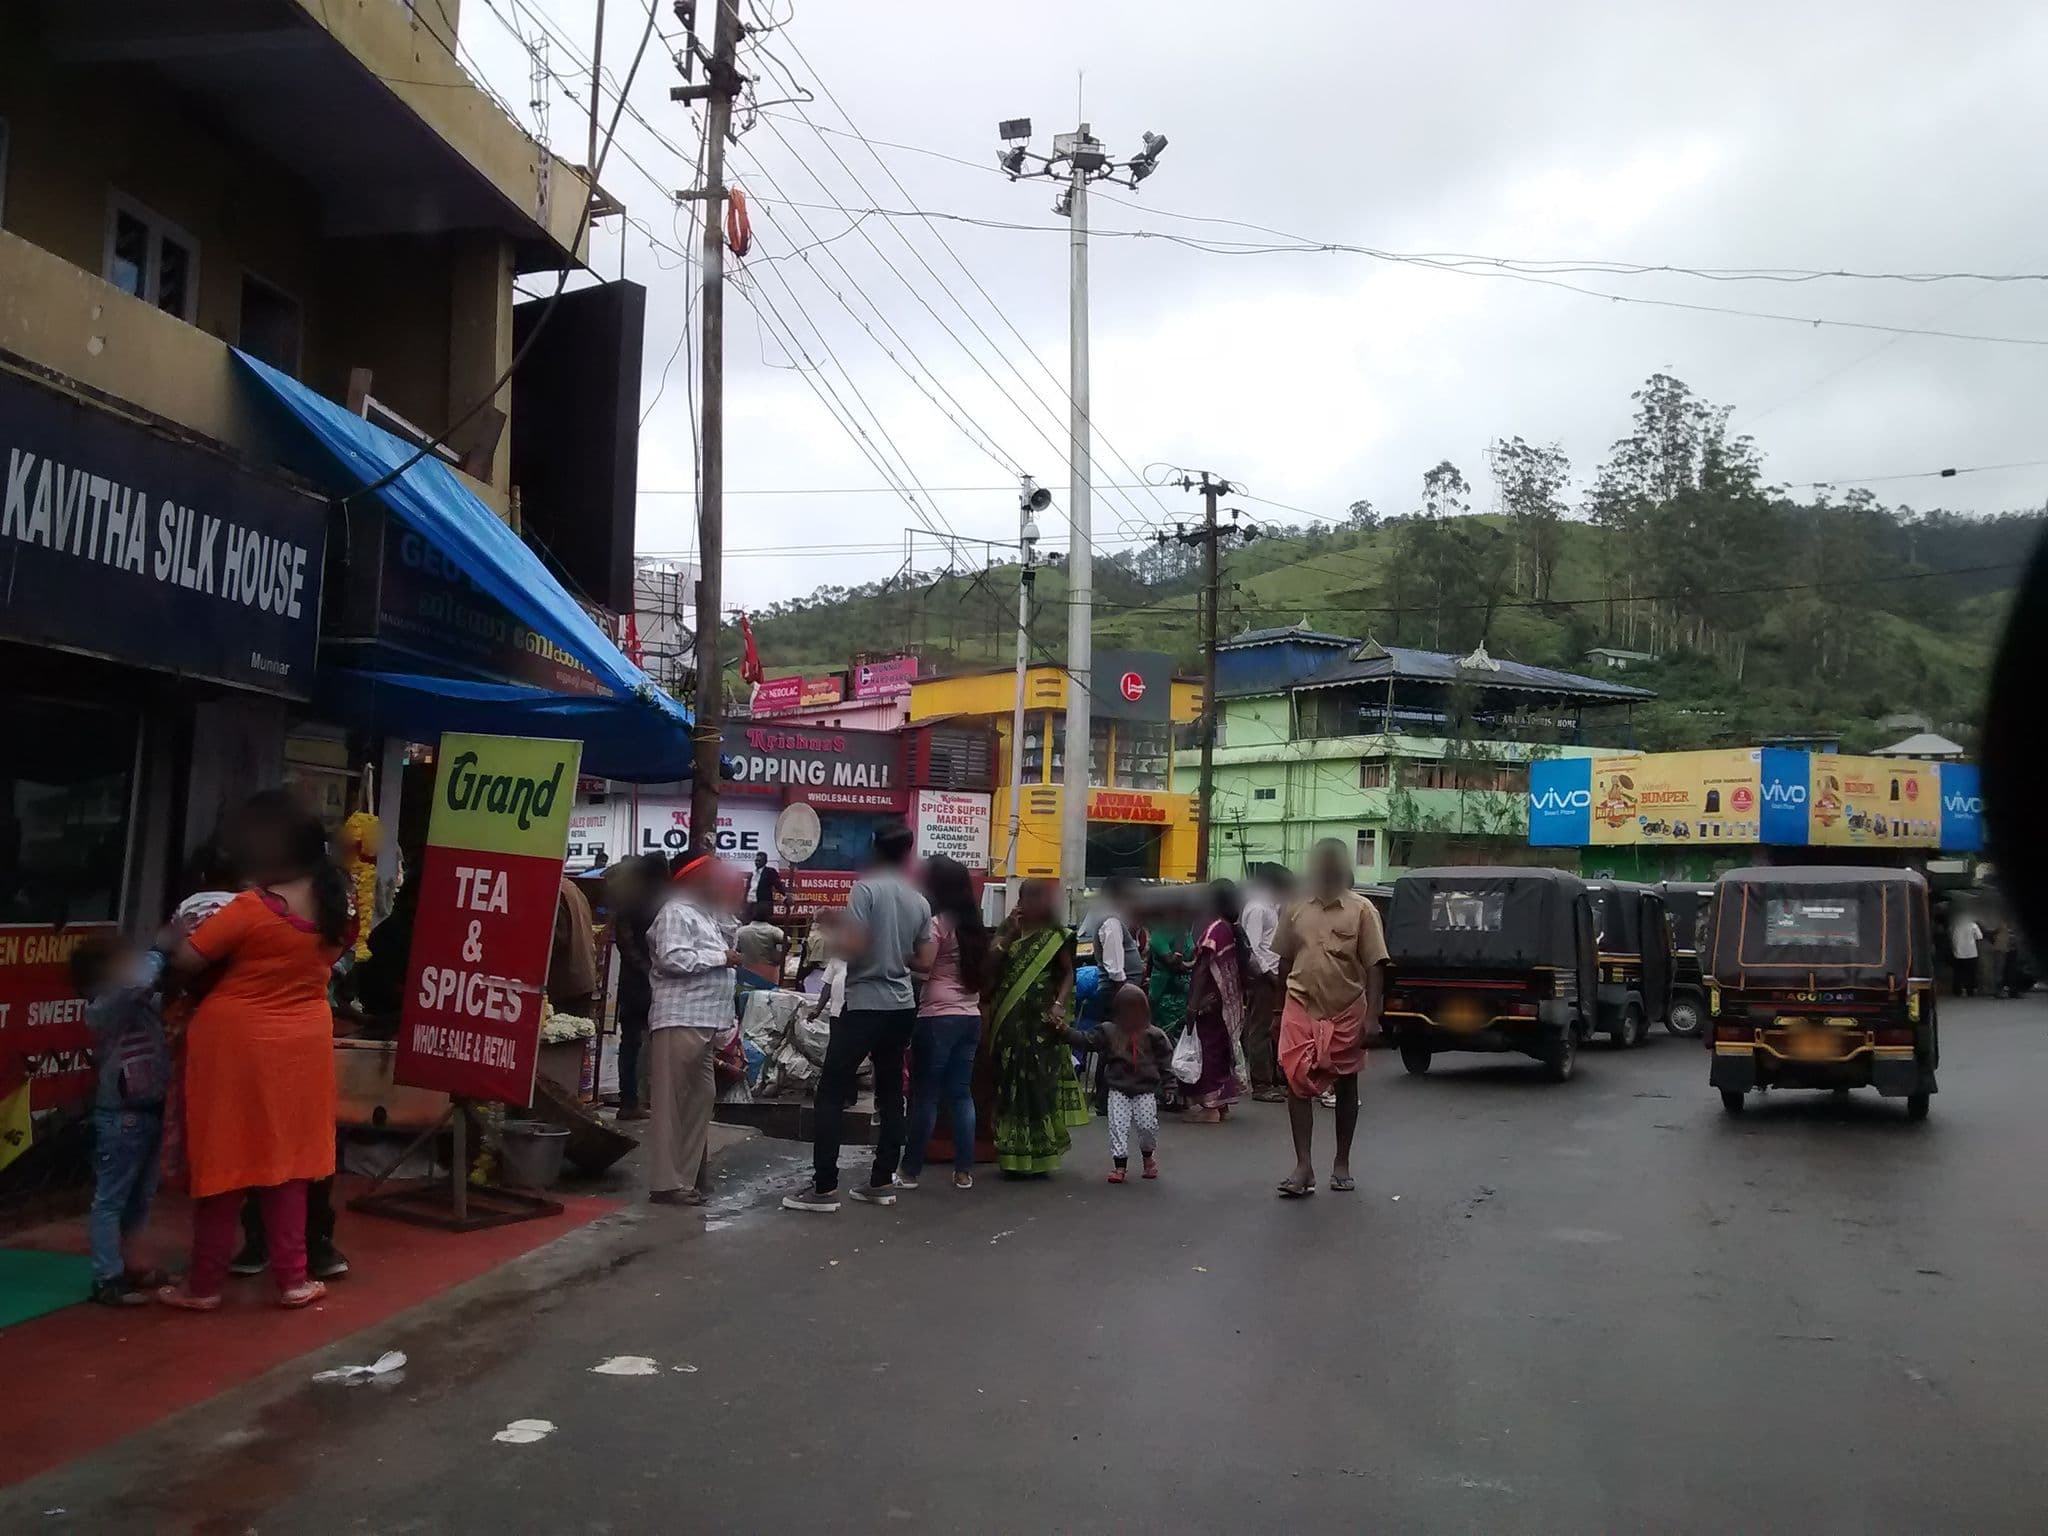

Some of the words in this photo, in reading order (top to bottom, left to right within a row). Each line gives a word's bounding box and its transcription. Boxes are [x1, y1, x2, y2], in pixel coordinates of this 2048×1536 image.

[2, 447, 148, 576] KAVITHA
[154, 497, 222, 595] SILK
[222, 523, 308, 620] HOUSE
[250, 651, 291, 677] Munnar
[731, 755, 826, 786] OPPING
[447, 750, 564, 831] Grand
[807, 792, 857, 804] WHOLESALE
[859, 795, 865, 804] &
[866, 795, 894, 806] RETAIL
[1641, 791, 1689, 804] BUMPER
[921, 803, 955, 814] SPICES
[957, 805, 987, 816] SUPER
[936, 815, 974, 826] MARKET
[643, 828, 760, 851] LOGE
[926, 824, 963, 833] ORGANIC
[965, 826, 980, 834] TEA
[930, 833, 975, 842] CARDAMOM
[937, 842, 968, 850] CLOVES
[951, 851, 981, 859] PEPPER
[455, 866, 509, 915] TEA
[801, 878, 839, 889] MASSAGE
[462, 920, 483, 963] &
[418, 964, 522, 1025] SPICES
[27, 997, 89, 1027] SWEET
[447, 1032, 472, 1063] SALE
[473, 1037, 483, 1064] &
[483, 1035, 518, 1071] RETAIL
